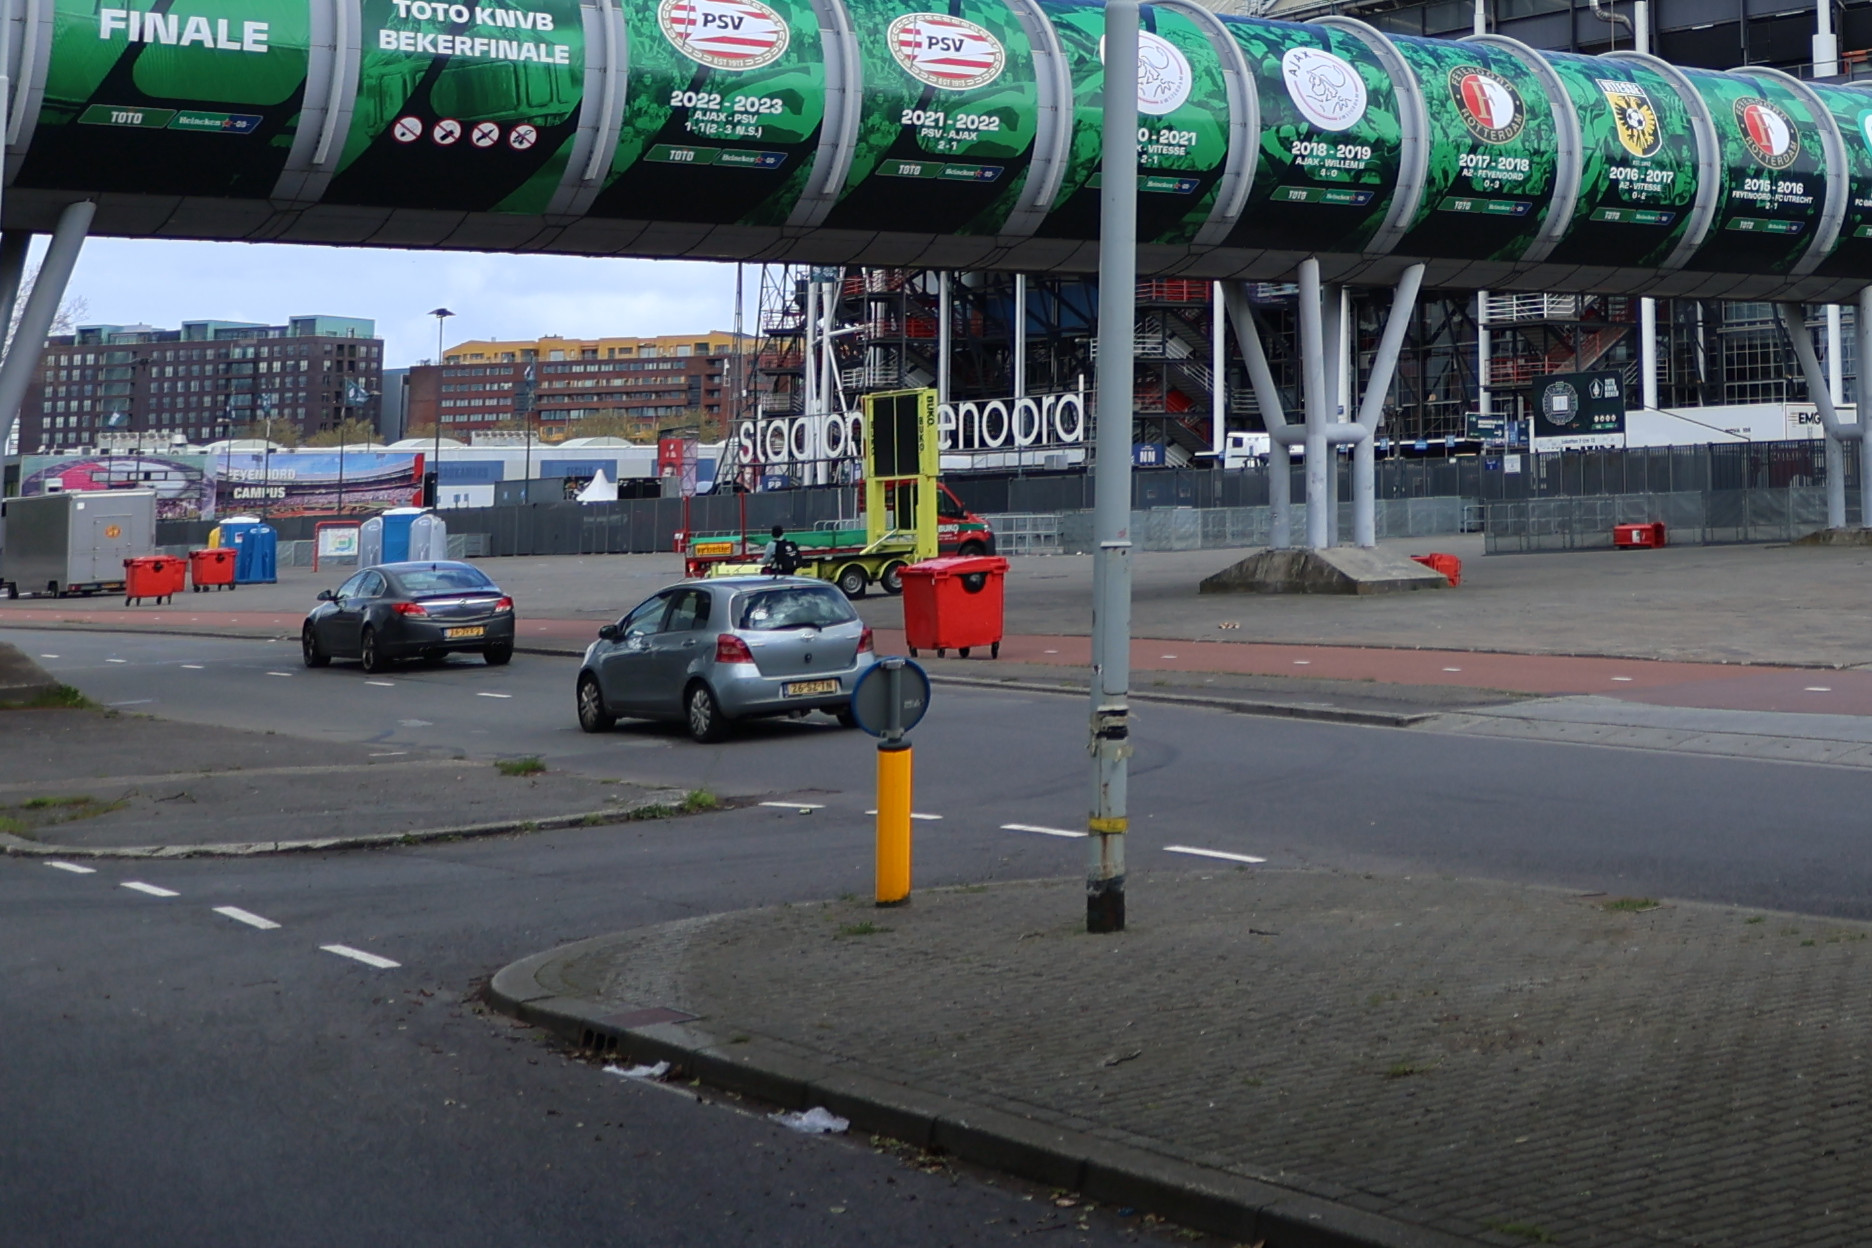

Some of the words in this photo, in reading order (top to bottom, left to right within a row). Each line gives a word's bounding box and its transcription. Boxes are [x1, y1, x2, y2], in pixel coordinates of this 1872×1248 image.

[393, 0, 469, 23] TOTO
[476, 7, 554, 31] KNVB
[702, 13, 744, 30] PSV
[100, 9, 268, 52] FINALE
[379, 29, 569, 64] BEKERFINALE
[927, 36, 964, 52] PSV
[1289, 51, 1313, 77] AJAX
[670, 90, 721, 109] 2022
[734, 96, 783, 114] 2023
[111, 110, 143, 124] TOTO
[179, 116, 221, 126] Heineken
[693, 111, 726, 121] AJAX
[734, 114, 757, 124] PSV
[901, 110, 944, 126] 2021
[956, 114, 999, 131] 2022
[1462, 108, 1523, 141] ROTTERDAM
[921, 128, 942, 137] PSV
[949, 132, 977, 140] AJAX
[1159, 130, 1196, 145] 2021
[670, 151, 694, 161] TOTO
[1148, 145, 1186, 156] VITESSE
[1292, 141, 1327, 156] 2018
[1337, 145, 1371, 159] 2019
[898, 165, 921, 175] TOTO
[1295, 157, 1319, 166] AJAX
[1325, 159, 1358, 169] WILLEM
[1459, 154, 1490, 168] 2017
[1498, 157, 1529, 171] 2018
[1478, 170, 1524, 181] FEYENOORD
[1609, 167, 1638, 180] 2016
[1646, 170, 1674, 183] 2017
[1744, 179, 1770, 192] 2015
[1778, 181, 1804, 194] 2016
[1140, 451, 1155, 463] NN
